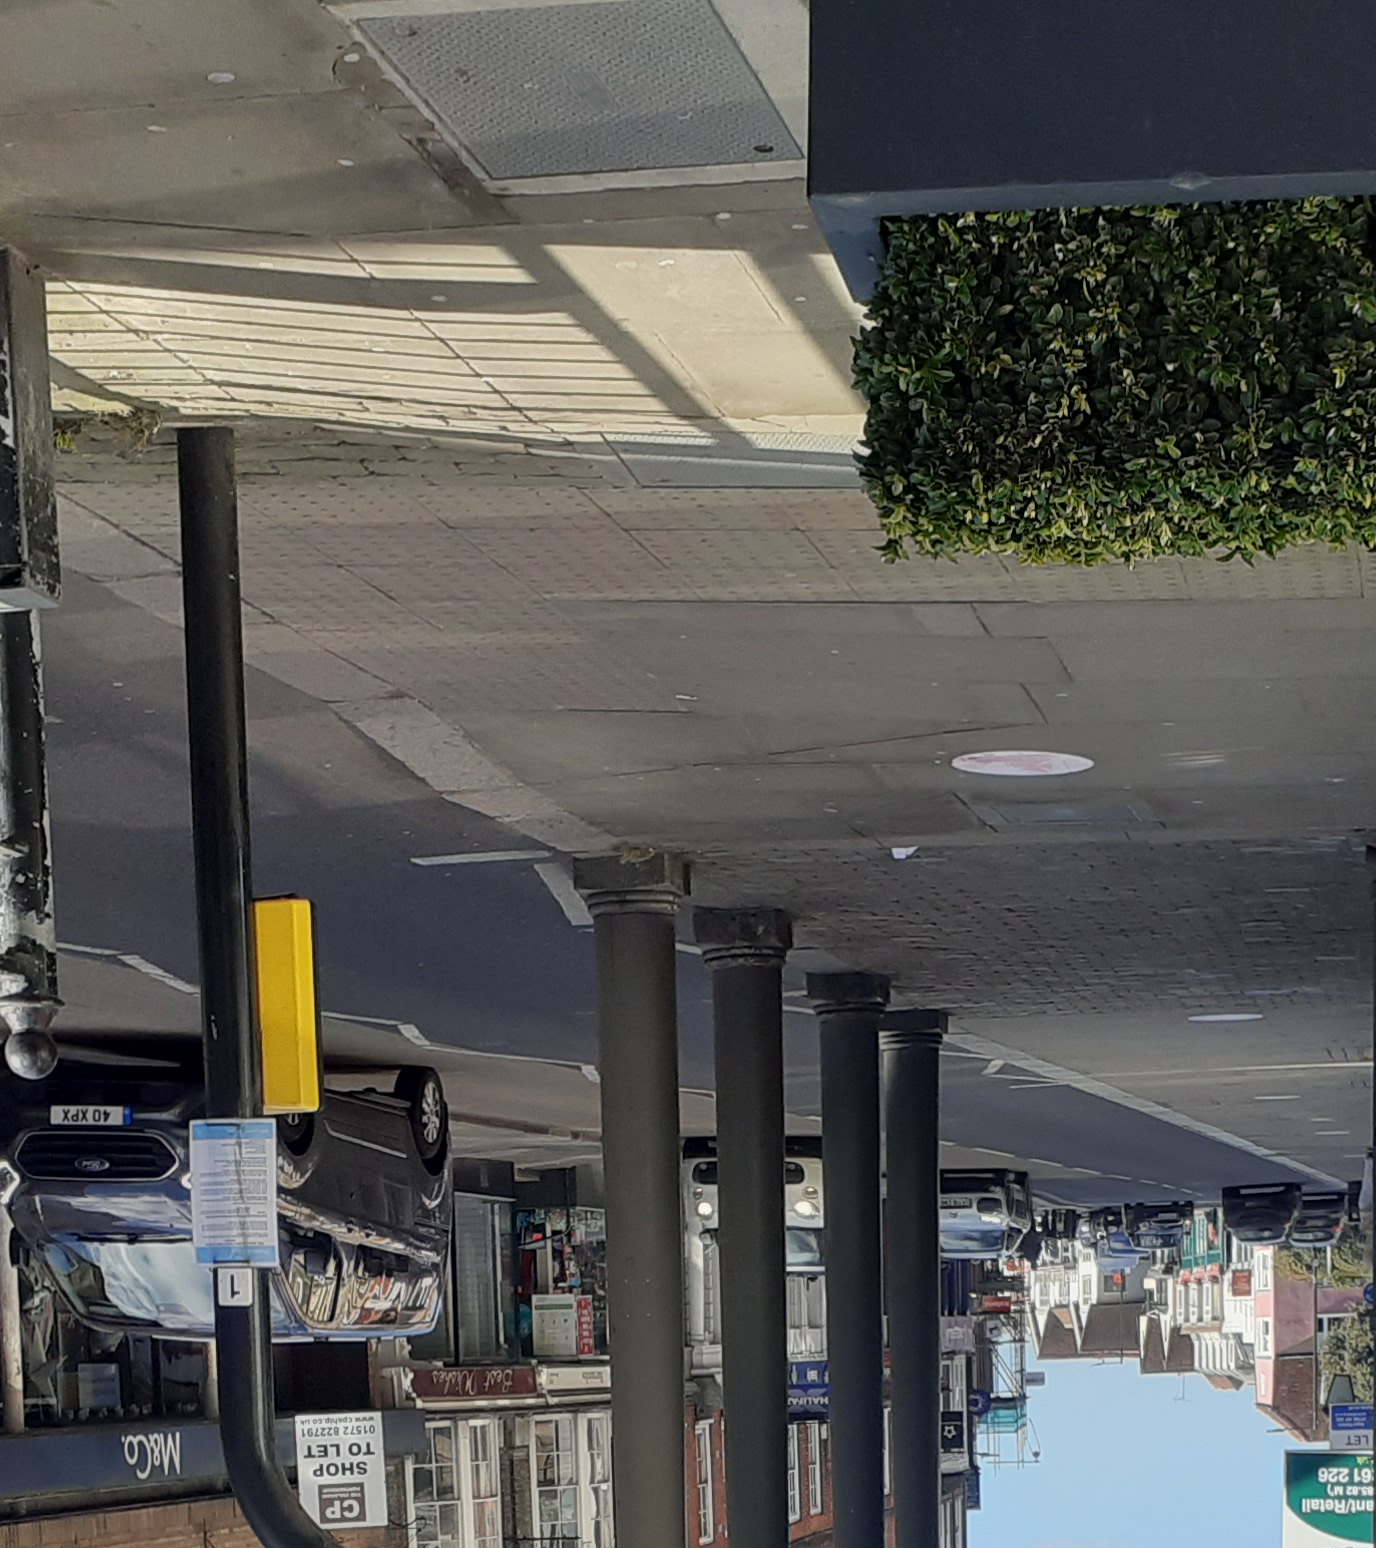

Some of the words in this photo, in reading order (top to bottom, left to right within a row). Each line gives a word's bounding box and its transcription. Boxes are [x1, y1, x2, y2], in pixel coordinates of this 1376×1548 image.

[61, 1108, 88, 1123] XPX
[93, 1109, 110, 1123] 40
[230, 1274, 241, 1299] 1
[431, 1368, 475, 1396] Wishes
[483, 1368, 513, 1392] Best
[301, 1426, 340, 1438] 822791
[343, 1424, 375, 1435] 01572
[1345, 1435, 1369, 1446] LET
[121, 1431, 181, 1480] M&Co.
[303, 1443, 340, 1459] LET
[348, 1442, 375, 1457] TO
[312, 1461, 368, 1477] SHOP
[1318, 1467, 1349, 1482] 226
[325, 1499, 360, 1519] CP
